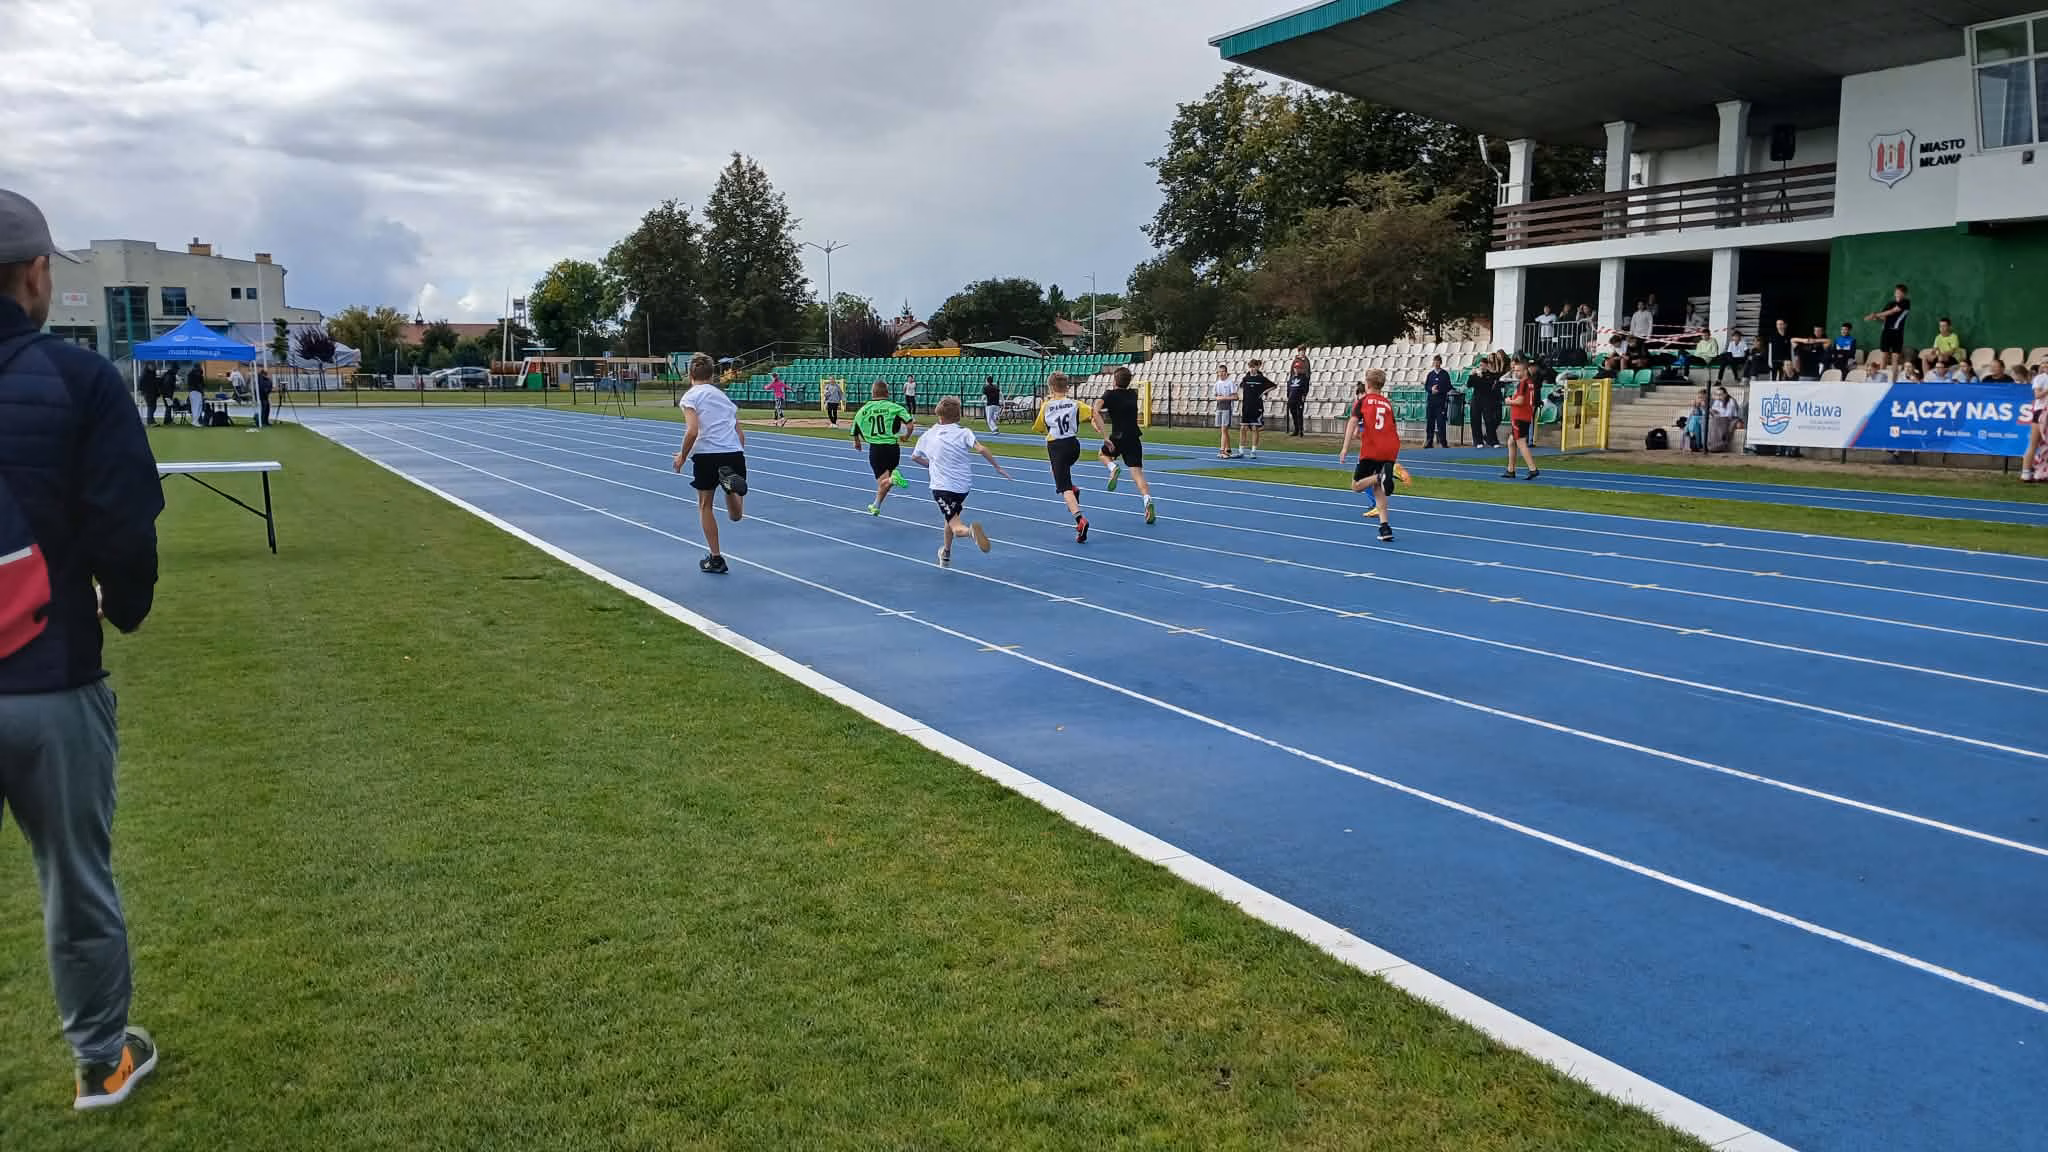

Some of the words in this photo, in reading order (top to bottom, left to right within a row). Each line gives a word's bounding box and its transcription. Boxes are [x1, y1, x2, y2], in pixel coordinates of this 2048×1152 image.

[1920, 139, 1965, 153] MIASTO
[1375, 407, 1386, 430] 5
[1796, 401, 1842, 417] Mława
[1891, 400, 1962, 422] ŁĄCZY
[1966, 402, 2013, 421] NAS
[868, 415, 886, 436] 20
[1054, 413, 1070, 436] 16
